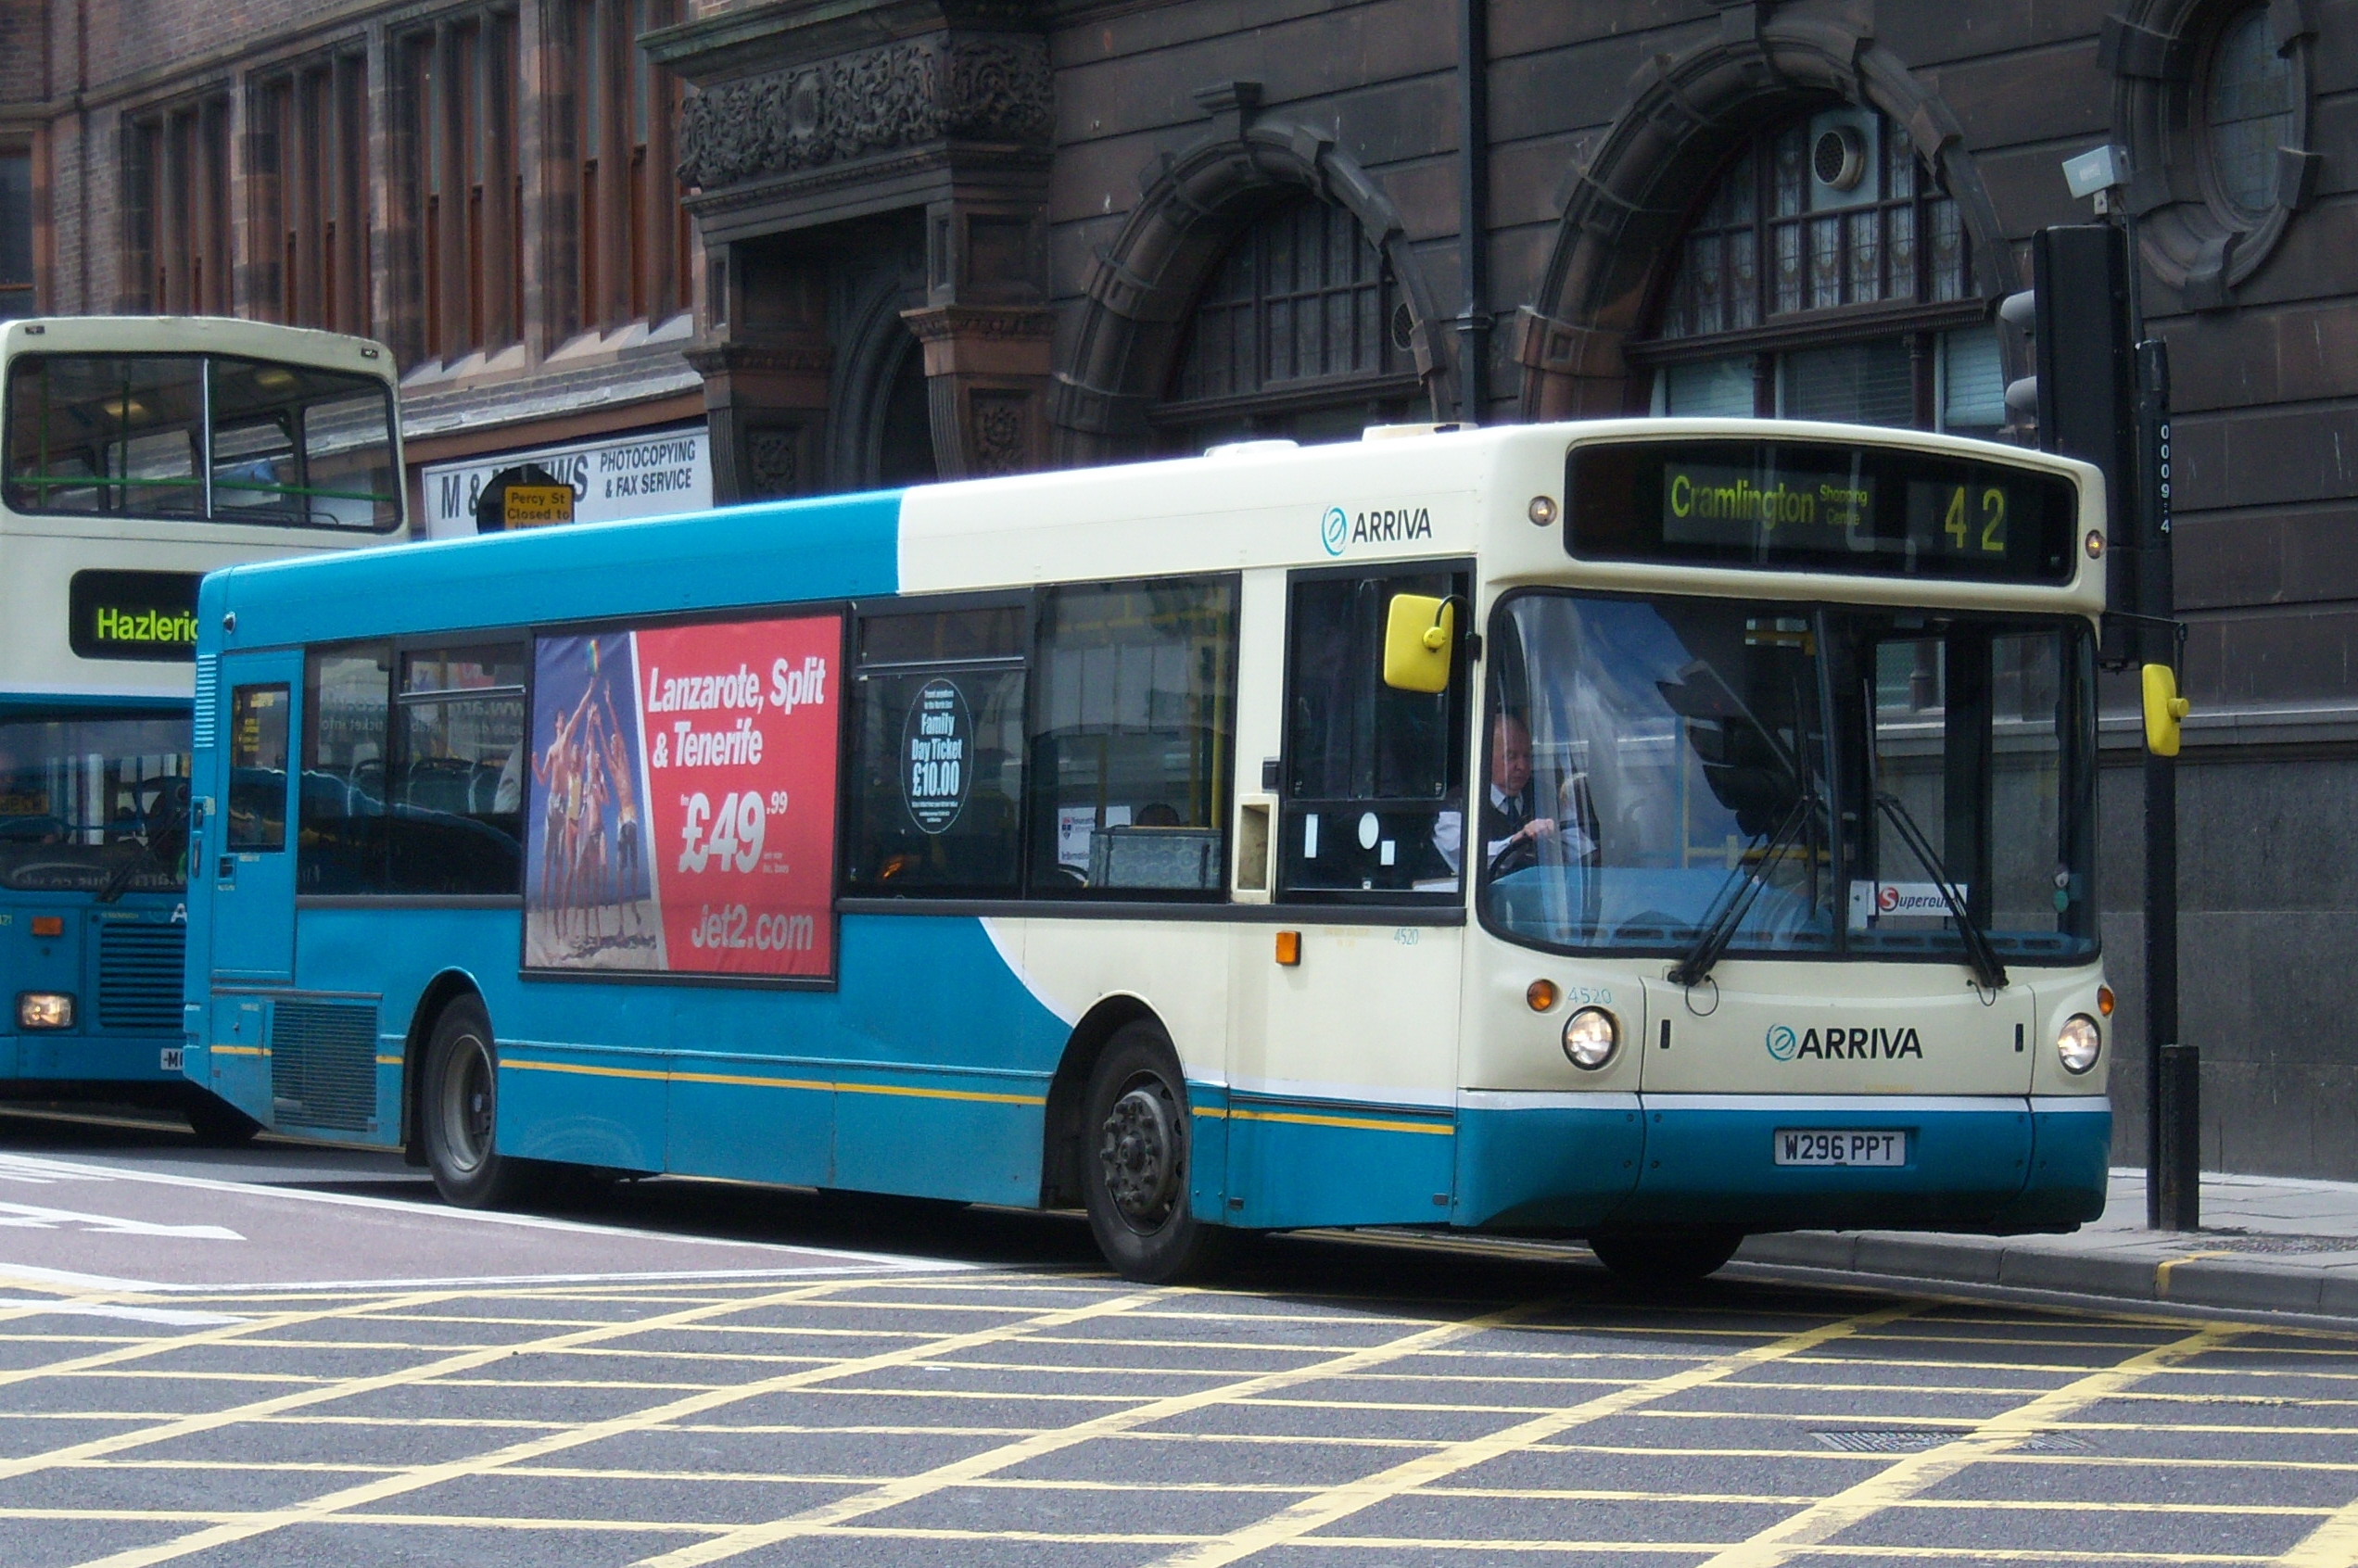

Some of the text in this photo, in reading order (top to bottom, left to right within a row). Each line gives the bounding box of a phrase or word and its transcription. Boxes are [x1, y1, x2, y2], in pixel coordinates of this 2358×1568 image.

[600, 439, 696, 473] PHOTOCOPYING
[441, 474, 461, 519] M
[468, 473, 480, 516] &
[511, 490, 564, 506] Percy St
[605, 479, 613, 499] &
[615, 474, 639, 498] FAX
[640, 467, 692, 494] SERVICE
[507, 508, 570, 521] Closed to
[1671, 474, 1868, 530] Cramlington Shopping
[1351, 507, 1432, 543] ARRIVA
[648, 656, 826, 715] Lanzarote, Split
[921, 712, 955, 737] Family
[653, 717, 763, 769] & Tenerife
[911, 738, 962, 763] Day Ticket
[912, 761, 960, 797] £10.00
[691, 904, 814, 950] jet2.com
[1394, 928, 1419, 945] 4520
[1568, 987, 1612, 1005] 4520
[1796, 1028, 1923, 1059] ARRIVA
[1785, 1135, 1895, 1160] W296 PPT
